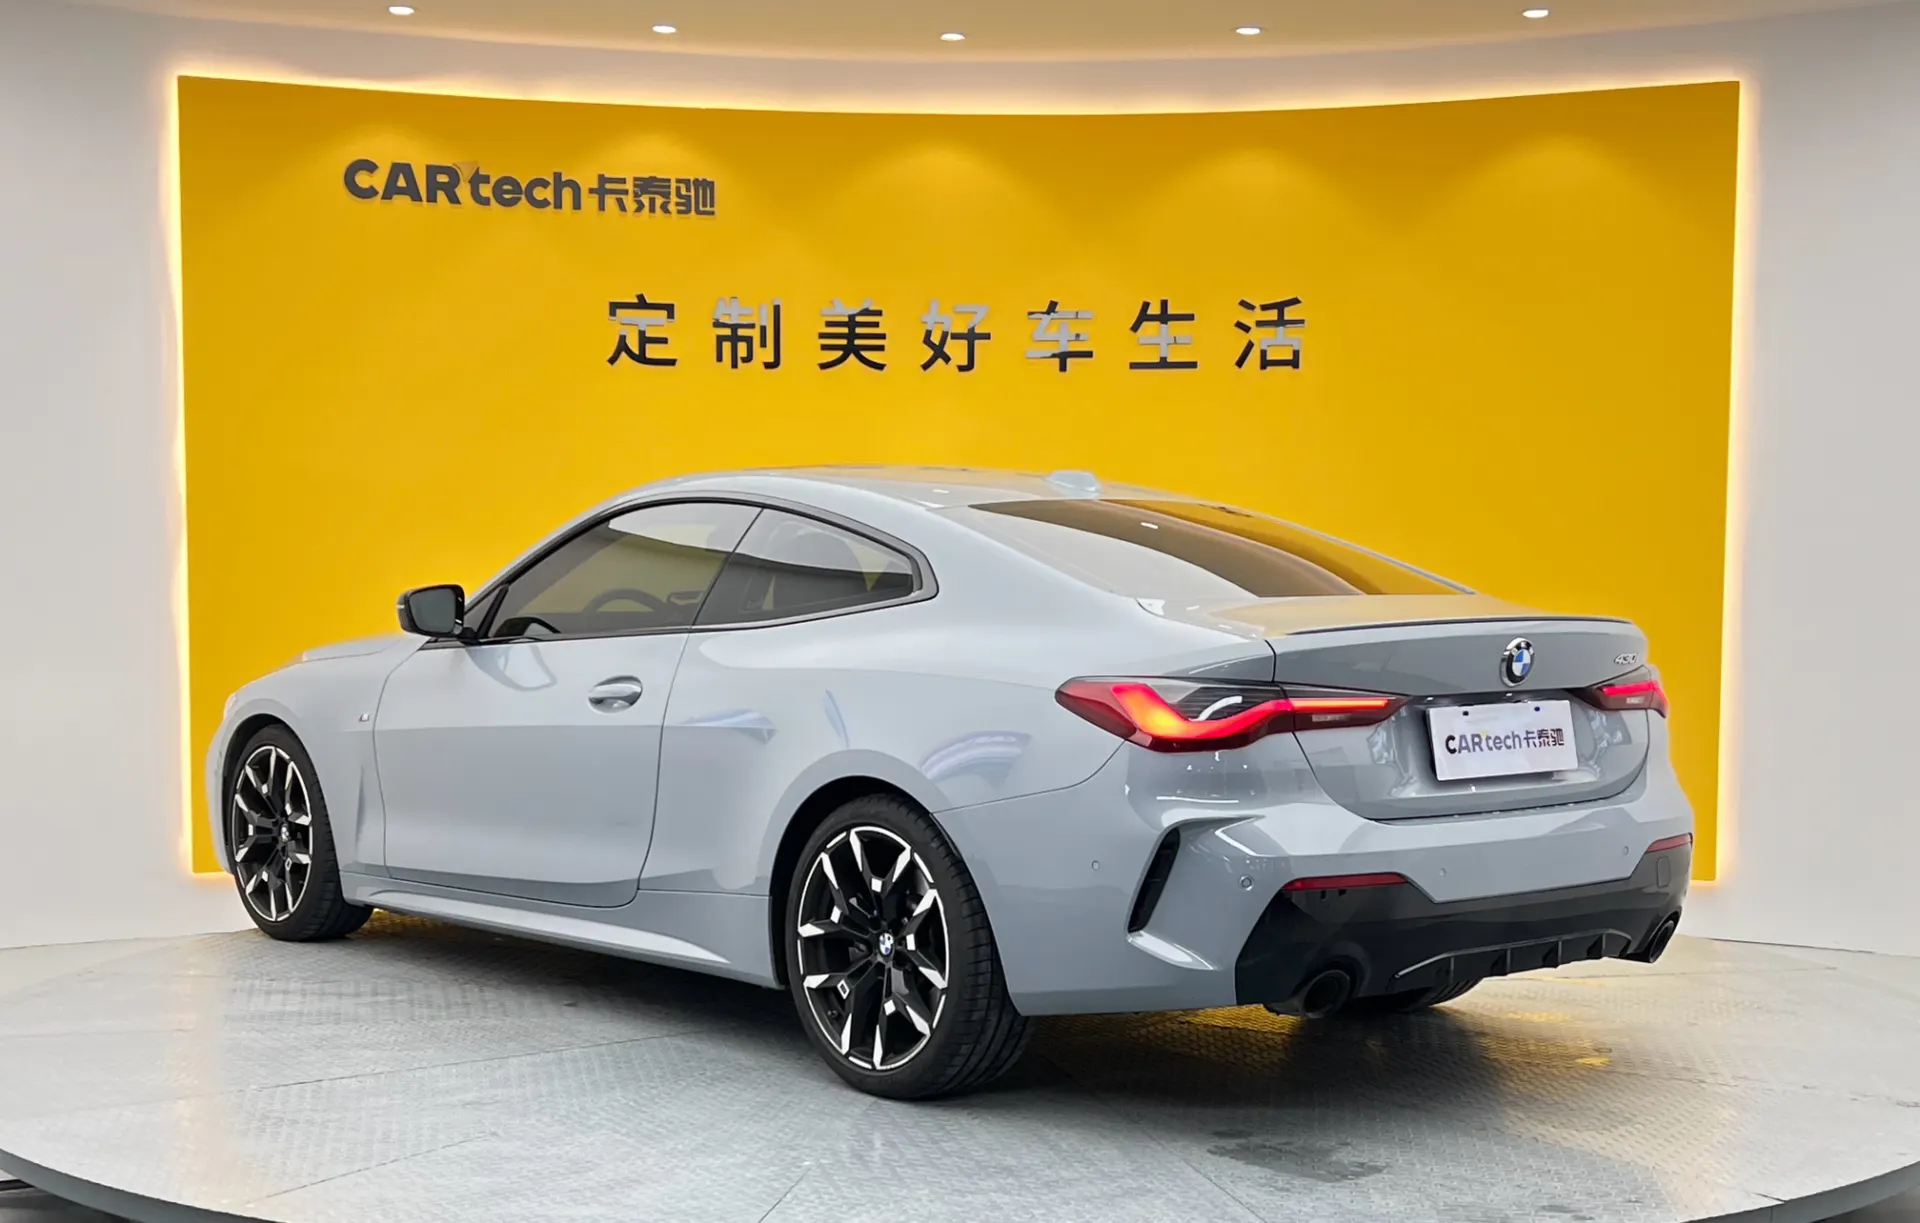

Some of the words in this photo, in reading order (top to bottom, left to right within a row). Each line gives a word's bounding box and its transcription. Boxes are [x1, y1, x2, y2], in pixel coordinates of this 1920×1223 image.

[344, 158, 582, 211] CARtech
[588, 173, 716, 216] 卡泰驰
[606, 293, 1308, 372] 定制美好车生活
[1444, 731, 1522, 754] CARtech
[1523, 728, 1565, 748] 卡泰驰
